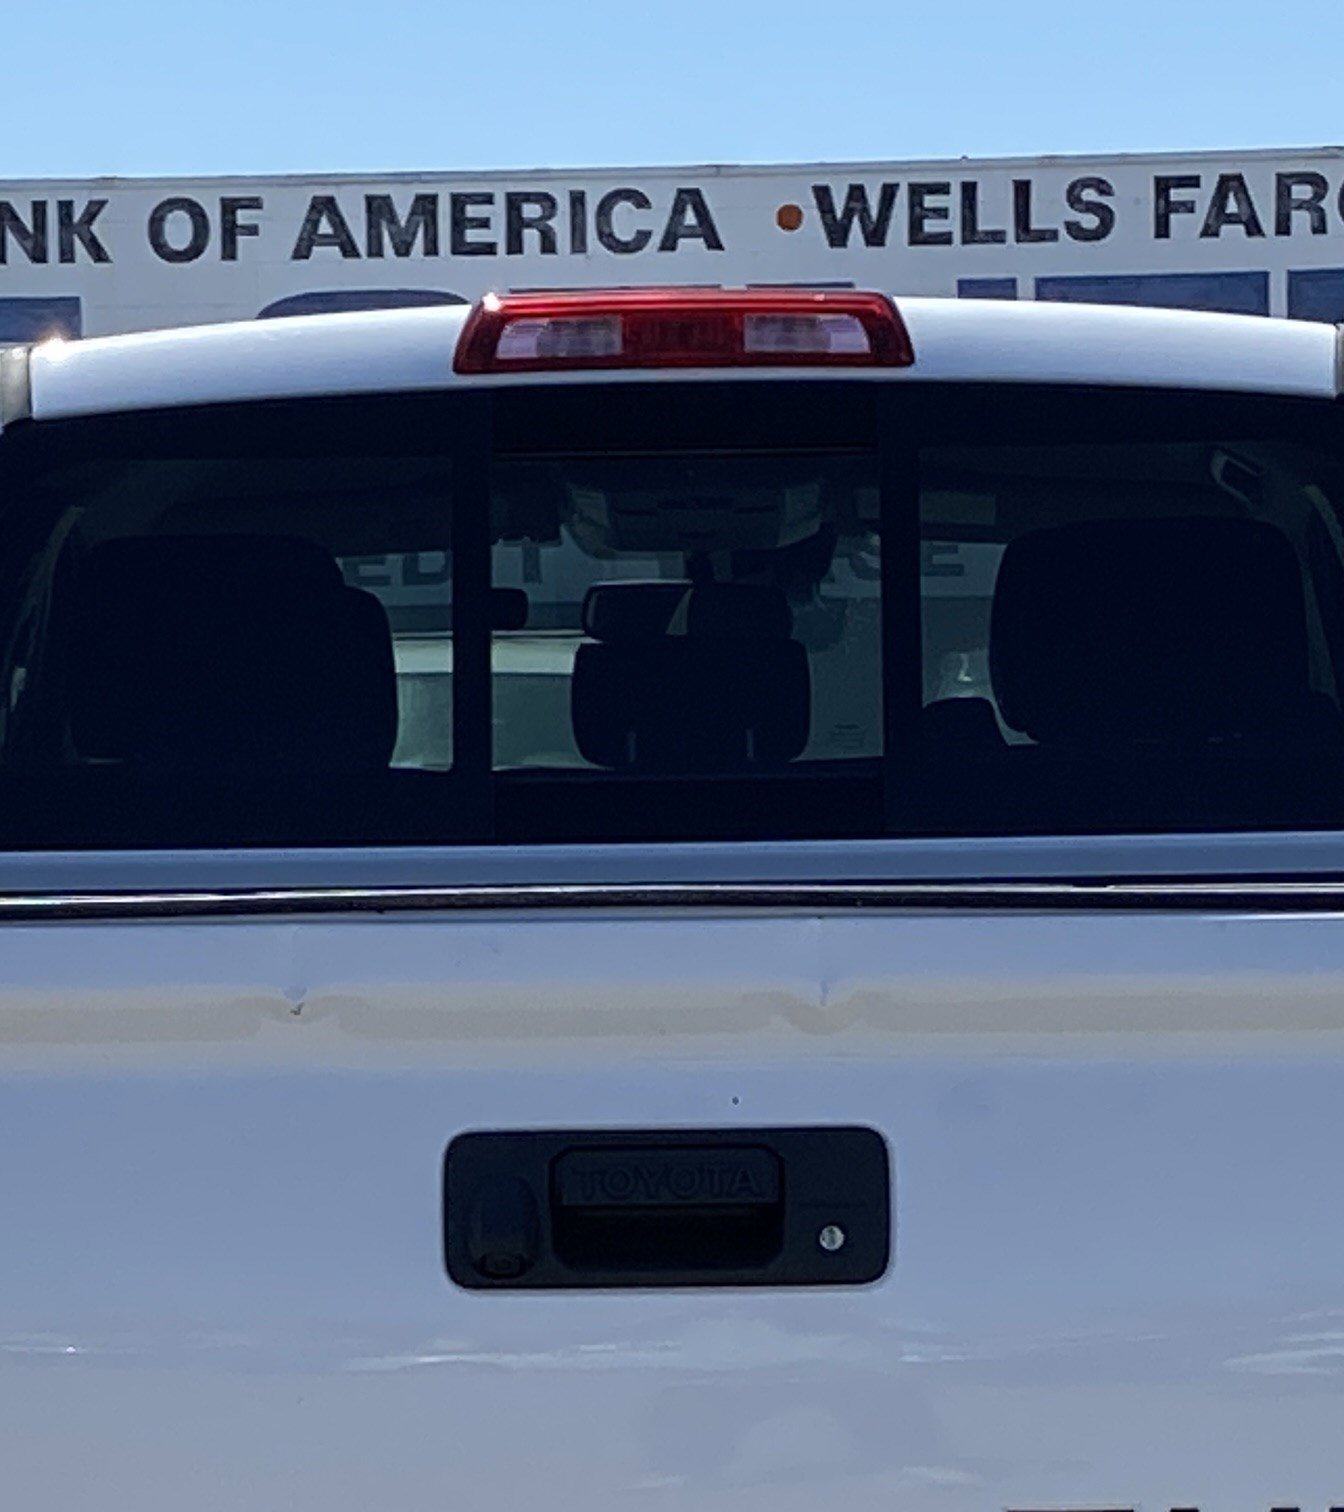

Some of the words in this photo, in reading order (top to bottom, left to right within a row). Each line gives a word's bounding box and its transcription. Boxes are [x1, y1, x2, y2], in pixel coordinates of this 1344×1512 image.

[148, 196, 263, 264] OF
[291, 187, 725, 260] AMERICA
[812, 176, 1115, 248] WELLS
[574, 1163, 762, 1199] TOYOTA
